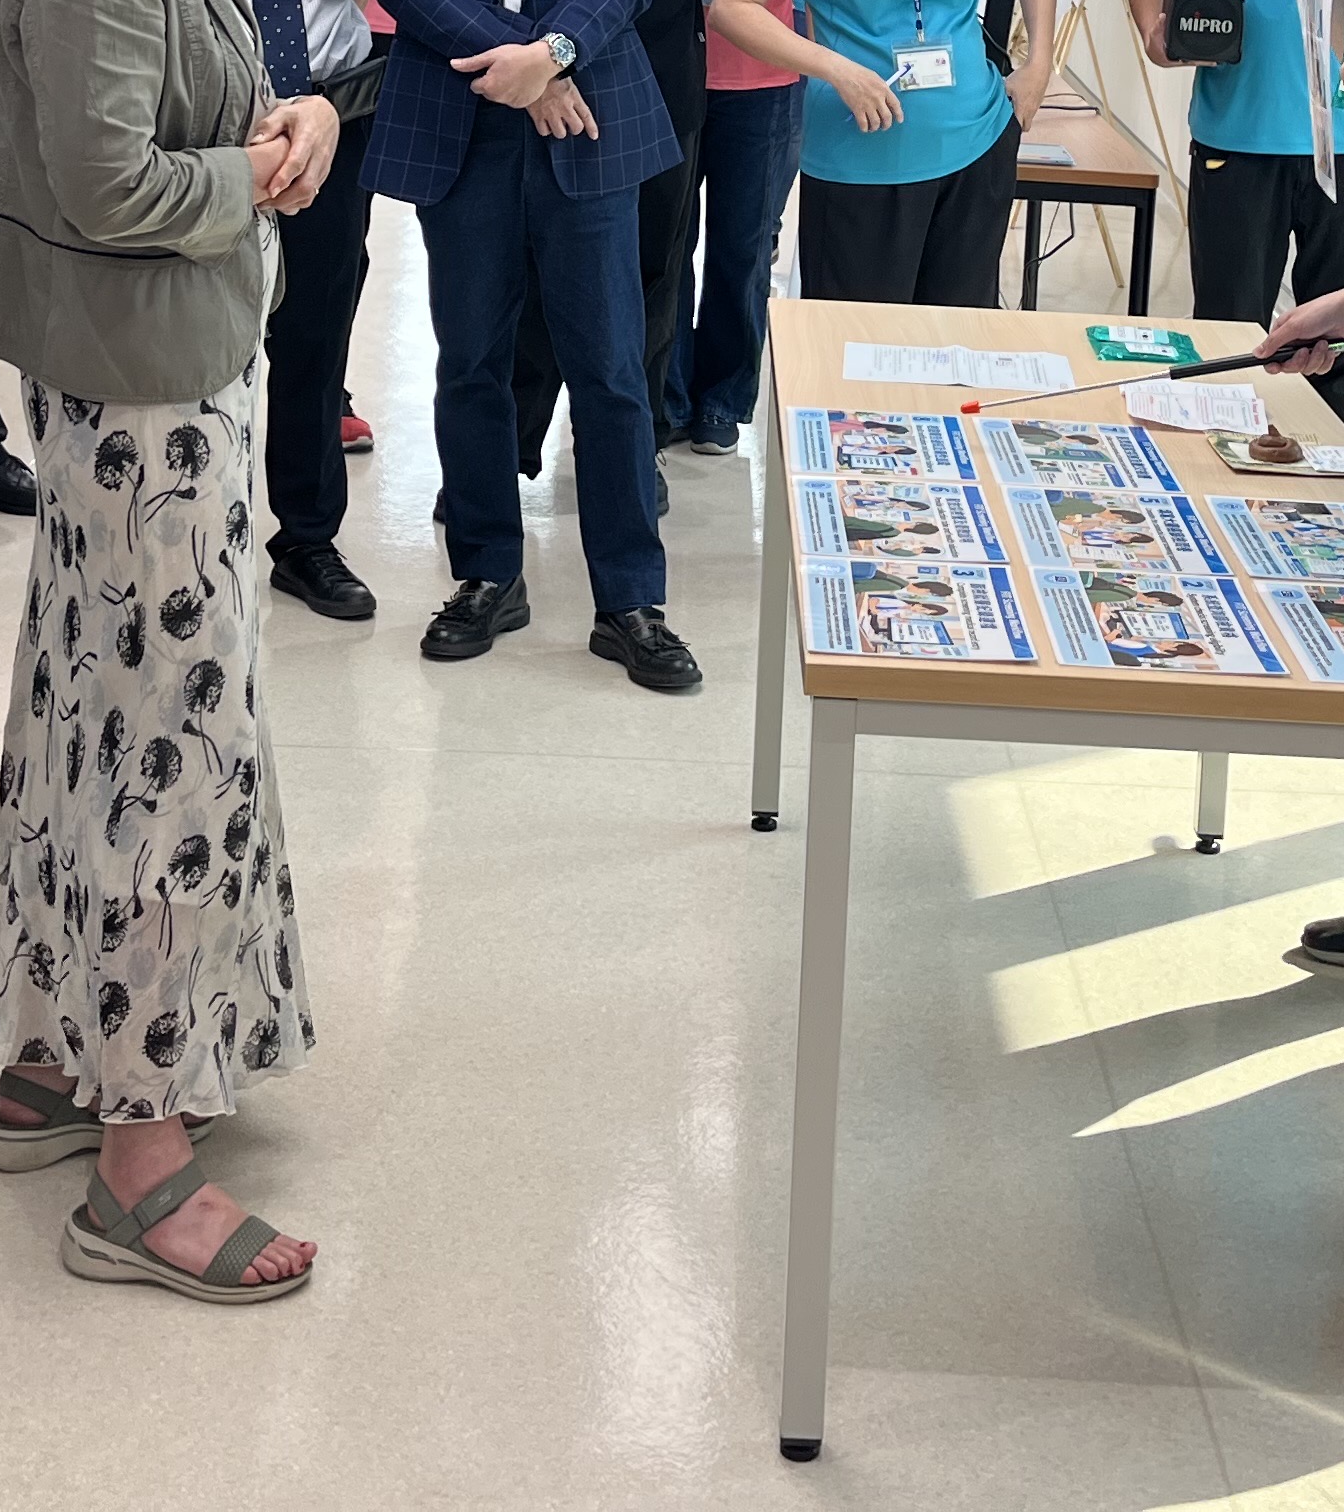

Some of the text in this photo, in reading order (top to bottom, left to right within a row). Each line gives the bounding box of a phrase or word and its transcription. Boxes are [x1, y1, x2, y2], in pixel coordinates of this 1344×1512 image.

[1179, 15, 1234, 34] MIPRO
[1234, 609, 1256, 630] Screening
[1248, 631, 1269, 652] Workflow
